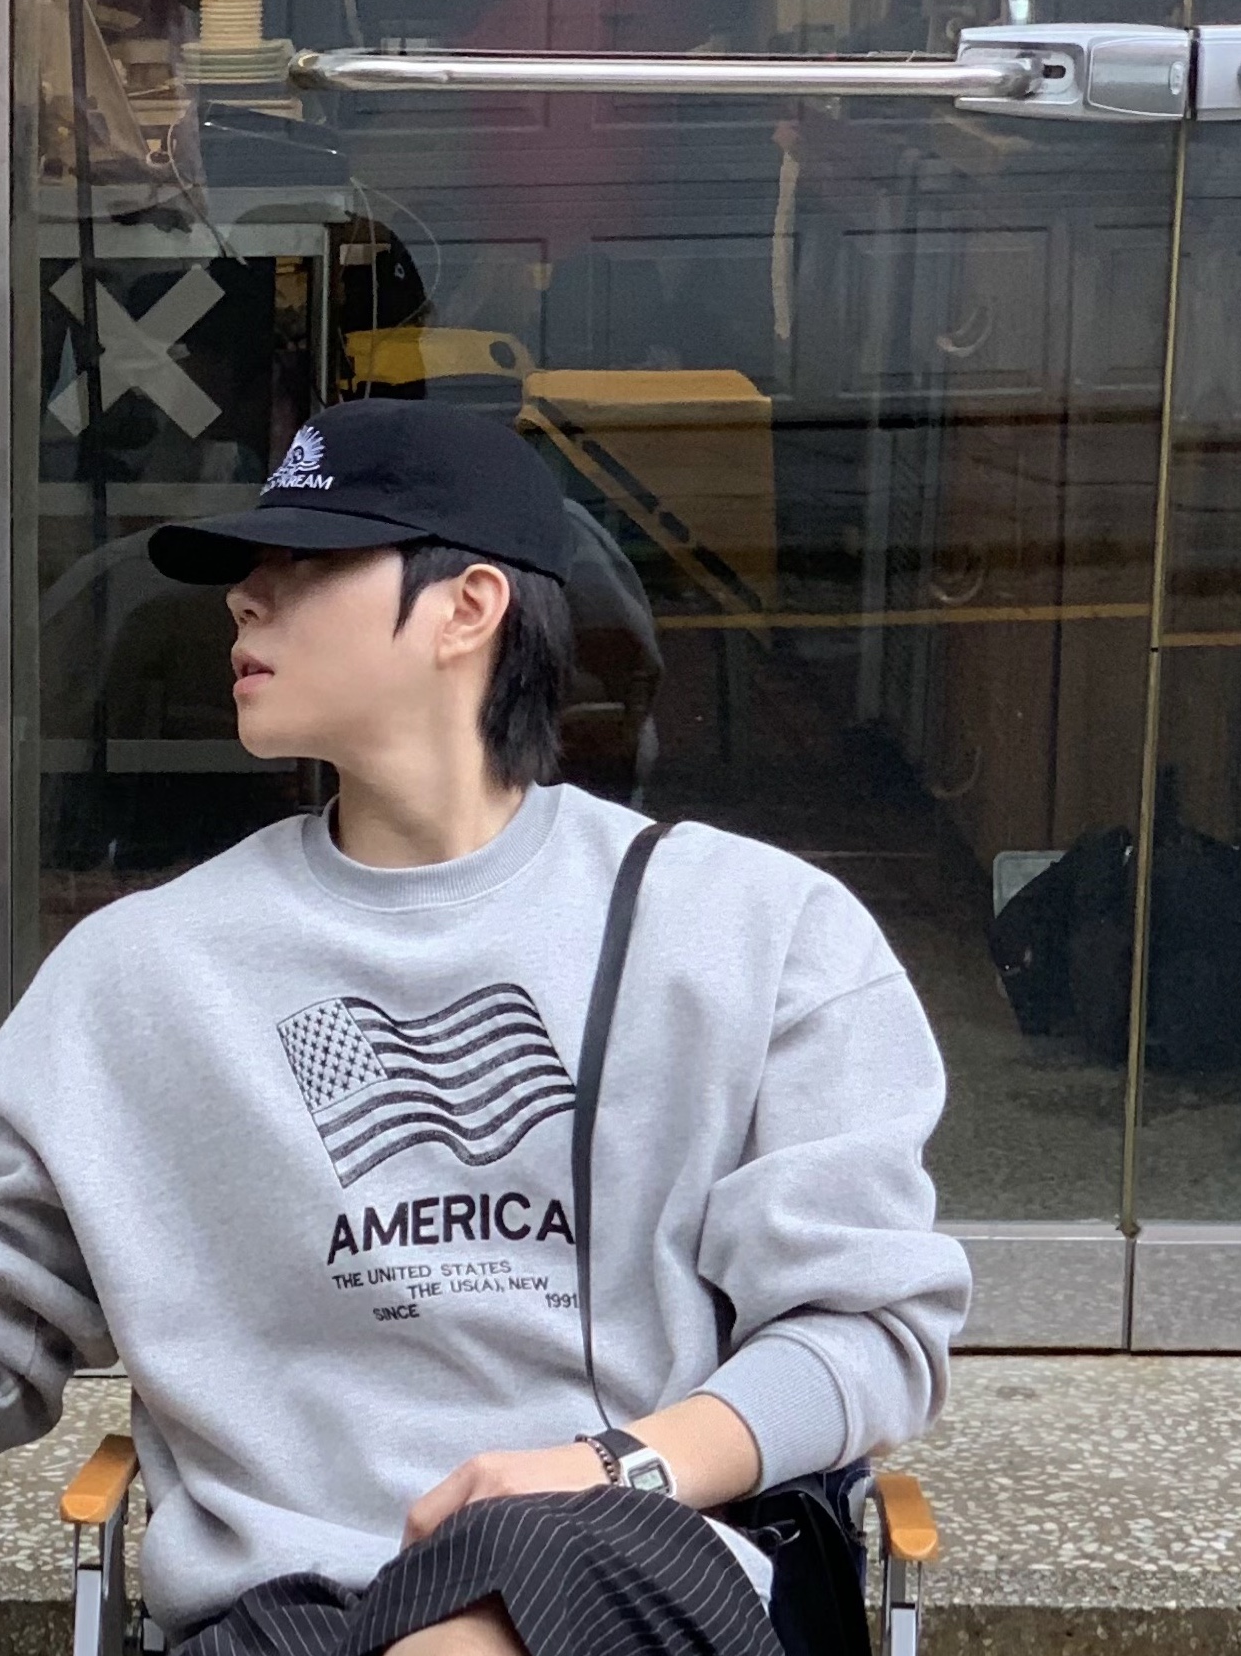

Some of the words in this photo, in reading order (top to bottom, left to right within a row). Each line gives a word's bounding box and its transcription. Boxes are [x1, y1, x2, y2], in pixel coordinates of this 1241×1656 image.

[327, 1192, 576, 1265] AMERICA
[332, 1272, 364, 1290] THE
[368, 1265, 432, 1285] UNITED
[440, 1259, 512, 1278] STATES
[407, 1281, 443, 1299] THE
[507, 1276, 549, 1291] NEW
[372, 1304, 420, 1321] SINCE
[545, 1293, 579, 1309] 1991
